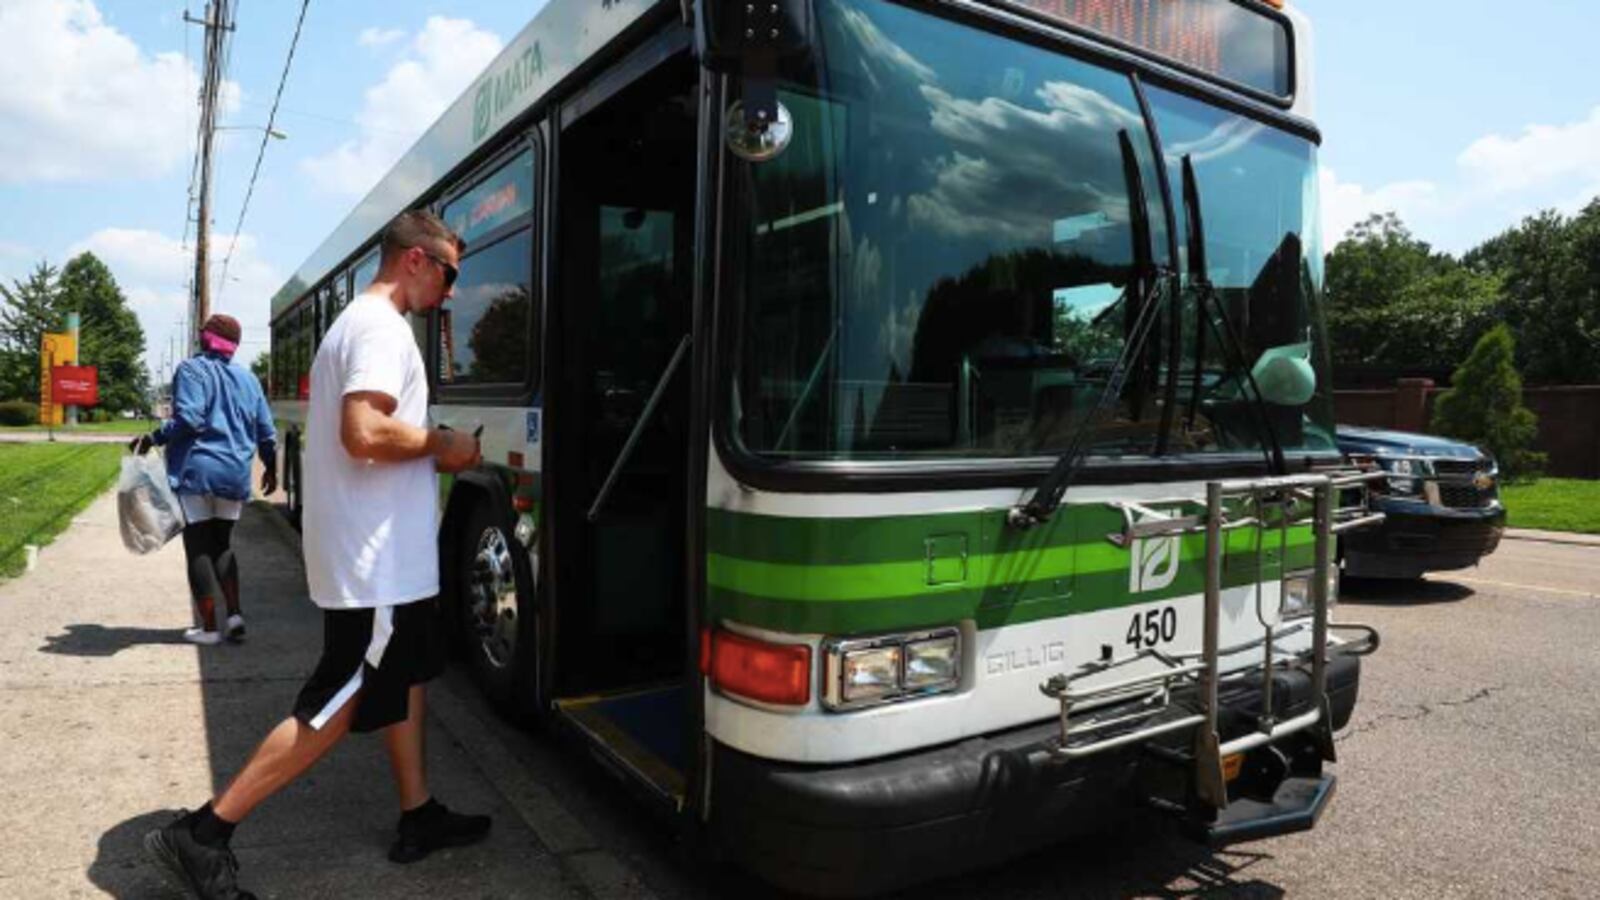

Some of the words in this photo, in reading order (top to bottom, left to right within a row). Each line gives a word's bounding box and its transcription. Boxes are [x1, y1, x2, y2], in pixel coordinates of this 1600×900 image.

[494, 41, 543, 115] MATA
[1126, 606, 1177, 649] 450
[986, 642, 1064, 674] GILLIG
